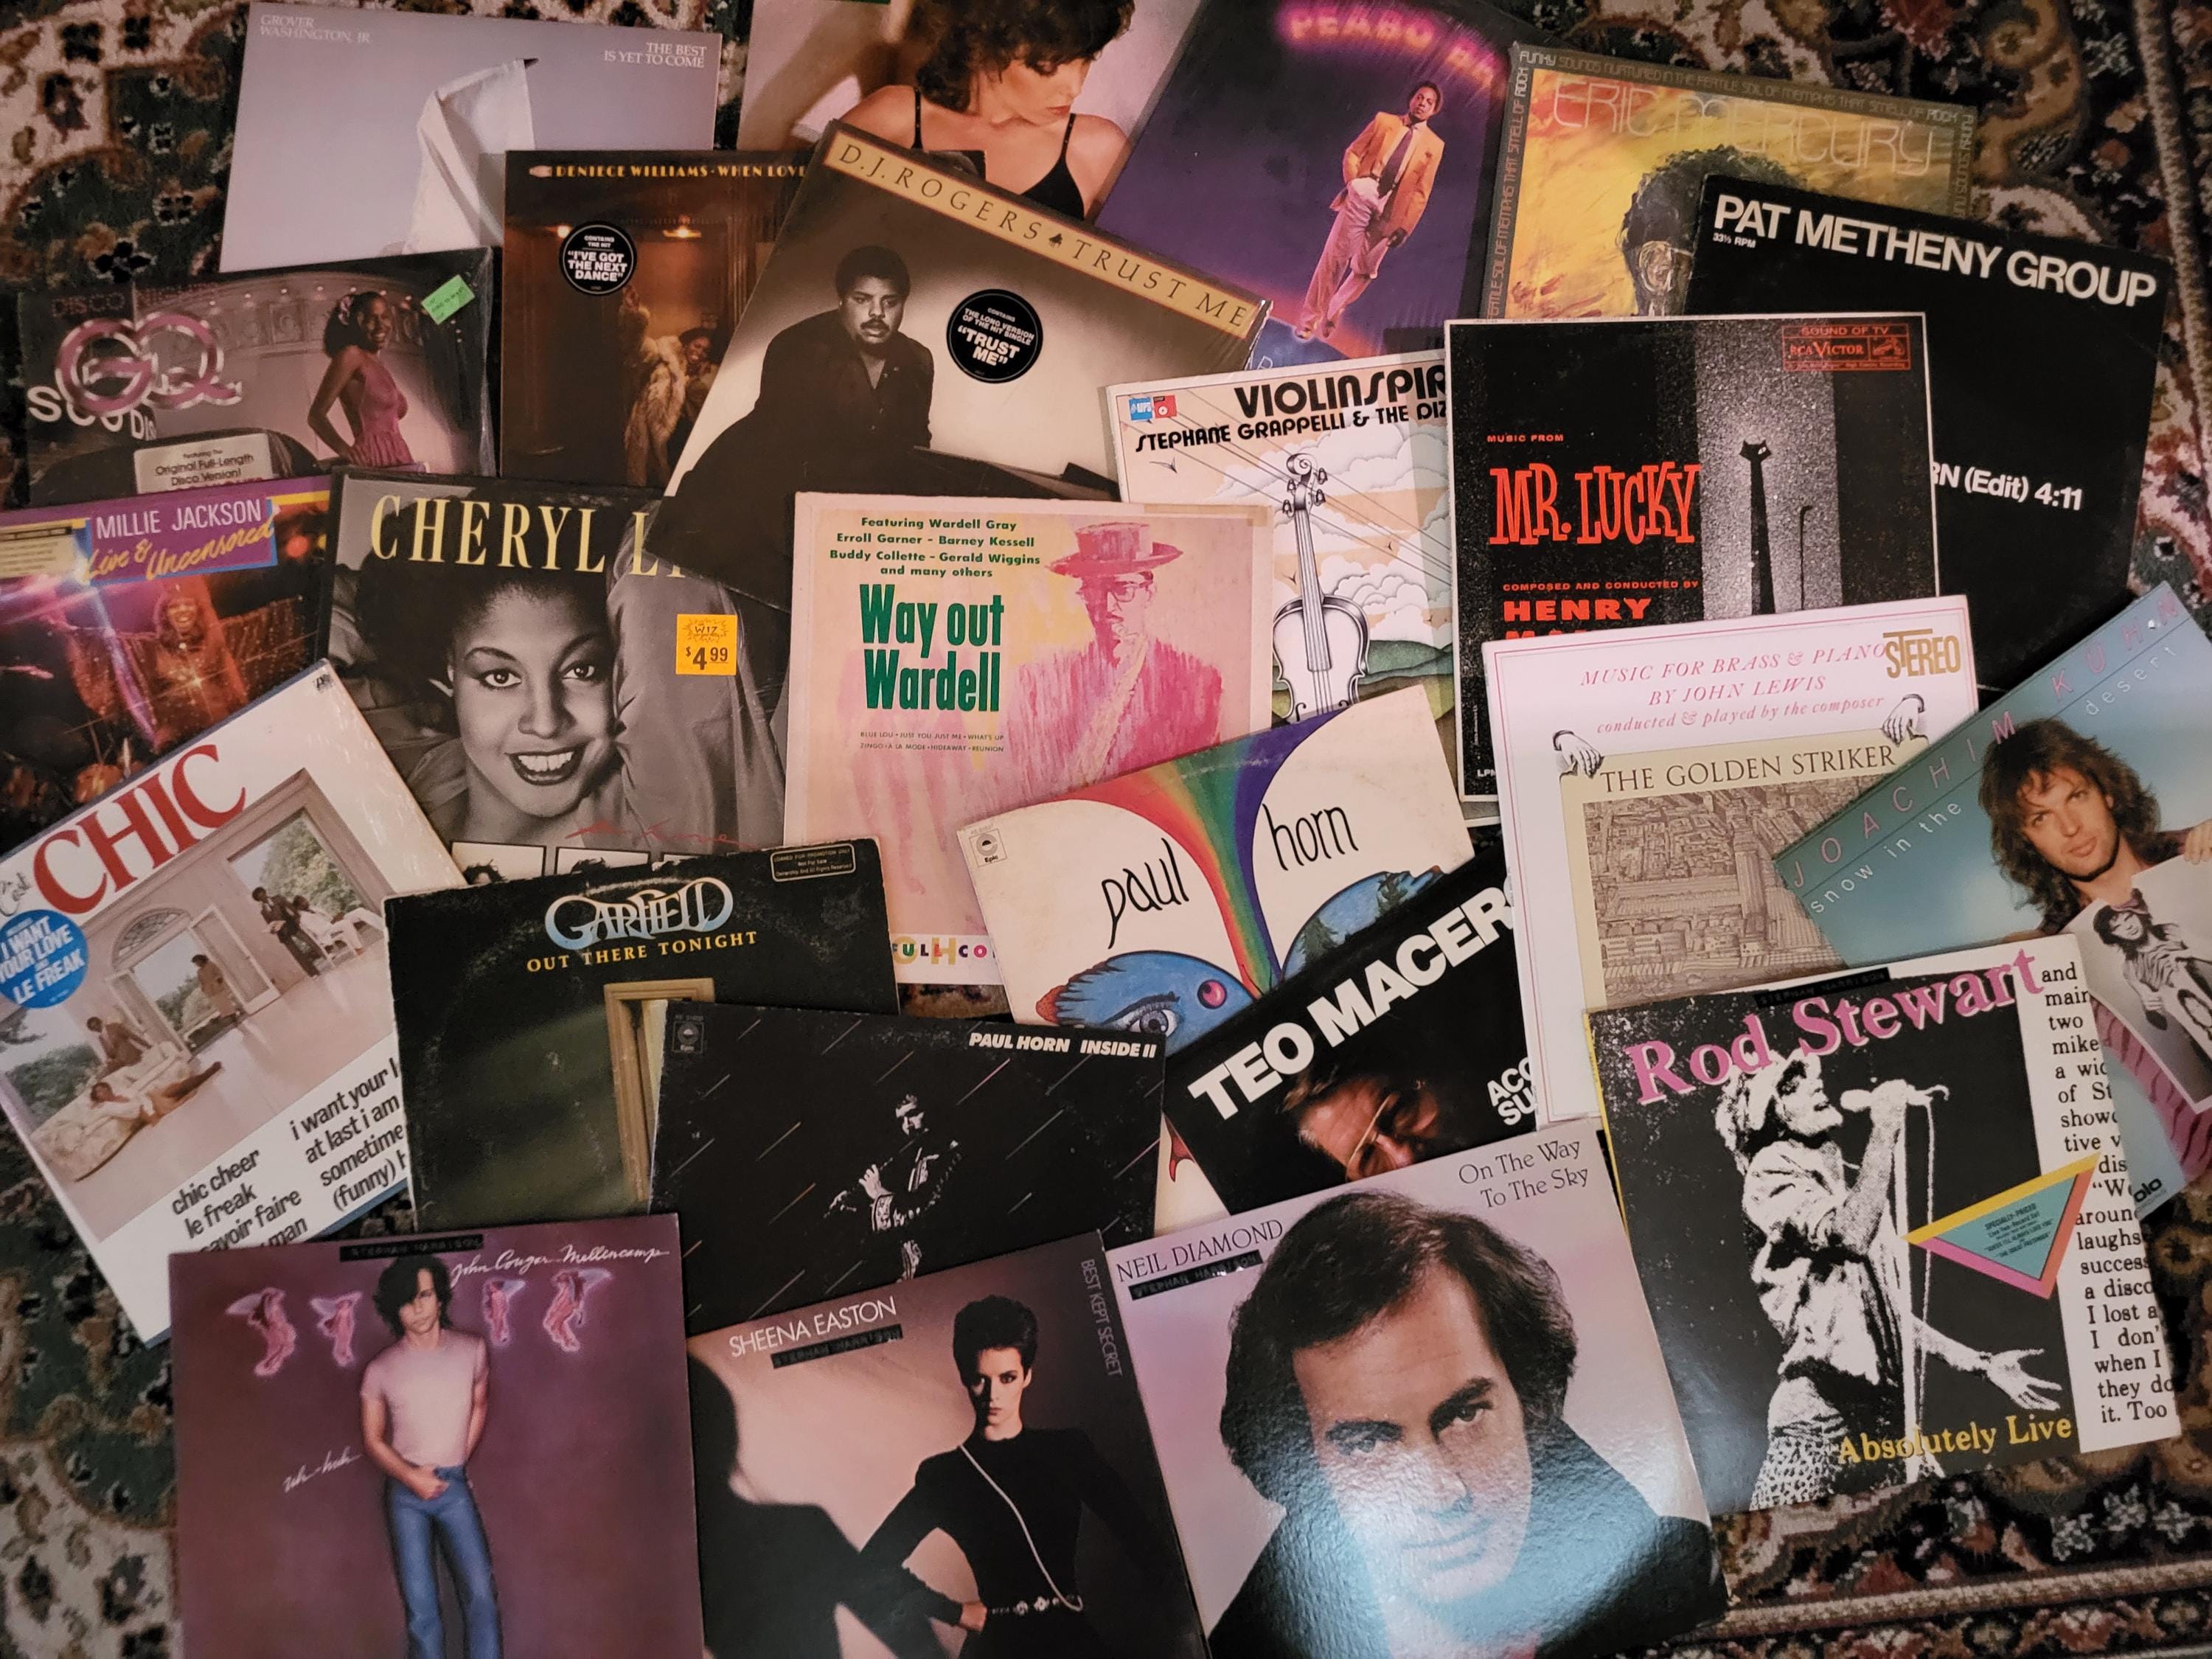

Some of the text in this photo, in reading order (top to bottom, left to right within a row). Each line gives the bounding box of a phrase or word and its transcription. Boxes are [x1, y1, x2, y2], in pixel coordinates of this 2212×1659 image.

[260, 15, 315, 27] GROVER
[604, 49, 705, 68] IS YET TO COME
[646, 43, 707, 58] THE BEST
[1554, 76, 1659, 137] ERIC
[556, 166, 625, 178] DENIECE
[631, 166, 709, 178] WILLIAMS
[717, 166, 762, 178] WHEN
[599, 252, 625, 263] GOT
[895, 167, 1250, 329] ROGERS TRUST ME
[1714, 194, 2157, 307] PAT METHENY GROUP
[1733, 236, 1756, 248] RPM
[568, 260, 628, 273] THE NEXT
[964, 308, 1035, 341] THE LONG VERSION
[1004, 330, 1032, 346] SINGLE
[1801, 325, 1890, 336] SOUND OF TV
[1790, 344, 1812, 356] RCA
[1135, 404, 1409, 453] STEPHANE GRAPPELLI & THE
[1487, 434, 1526, 442] MUSIC
[156, 453, 254, 476] Original Full-Length
[171, 474, 201, 487] Disco
[1489, 461, 1702, 545] MR. LUCKY
[1964, 467, 2083, 510] (Edit) 4:11
[97, 499, 262, 540] MILLIE JACKSON
[371, 495, 606, 573] CHERYL
[861, 518, 1017, 531] Featuring Wardell Gray
[146, 520, 275, 581] Uncensored
[830, 549, 1040, 566] Buddy Collette Gerald Wiggins
[837, 533, 1034, 547] Erroll Garner Barney Kessell
[880, 566, 992, 578] and many others
[1503, 582, 1571, 591] COMPOSED
[1605, 580, 1678, 589] CONDUCTED
[1683, 580, 1699, 588] BY
[859, 584, 1004, 658] Way out
[1503, 598, 1652, 622] HENRY
[1580, 643, 1886, 686] MUSIC FOR BRASS & PIANO
[1883, 628, 1961, 678] STEREO
[863, 649, 1001, 712] Wardell
[1648, 675, 1826, 707] BY JOHN LEWIS
[1596, 695, 1885, 735] conducted & played by the composer
[1599, 745, 1897, 794] THE GOLDEN STRIKER
[1810, 644, 2177, 914] snow in the desert
[1792, 710, 2018, 889] JOACHIM
[33, 744, 246, 914] CHIC
[1101, 804, 1359, 950] paul horn
[545, 877, 734, 950] GARFIELD
[8, 916, 52, 955] WANT
[34, 923, 74, 960] LOVE
[526, 931, 758, 973] OUT THERE TONIGHT
[13, 948, 86, 1005] LE FREAK
[2042, 961, 2078, 983] and
[1624, 947, 2044, 1106] Rod Stewart
[2048, 1015, 2084, 1031] two
[968, 1032, 1157, 1059] PAUL HORN INSIDE II
[2052, 1034, 2100, 1055] mike
[1188, 1022, 1315, 1121] TEO
[2055, 1066, 2066, 1079] a
[300, 1068, 389, 1135] want your
[2058, 1084, 2078, 1104] of
[305, 1095, 401, 1164] at last am
[2065, 1135, 2101, 1152] tive
[172, 1148, 260, 1215] chic cheer
[1458, 1140, 1580, 1184] On The Way
[333, 1158, 397, 1212] (funny)
[1480, 1168, 1588, 1208] To The Sky
[184, 1181, 257, 1239] le freak
[254, 1189, 303, 1228] faire
[1116, 1219, 1283, 1282] NEIL DIAMOND
[2076, 1228, 2142, 1251] laughs
[2084, 1286, 2096, 1299] a
[729, 1319, 812, 1357] SHEENA
[813, 1295, 897, 1336] EASTON
[1081, 1259, 1124, 1377] BEST KEPT SECRET
[2086, 1303, 2140, 1324] I lost
[2090, 1329, 2100, 1349] I
[2094, 1353, 2147, 1374] when
[2098, 1378, 2140, 1399] they
[2101, 1401, 2168, 1423] it. Too
[1838, 1413, 2072, 1464] Absolutely Live
